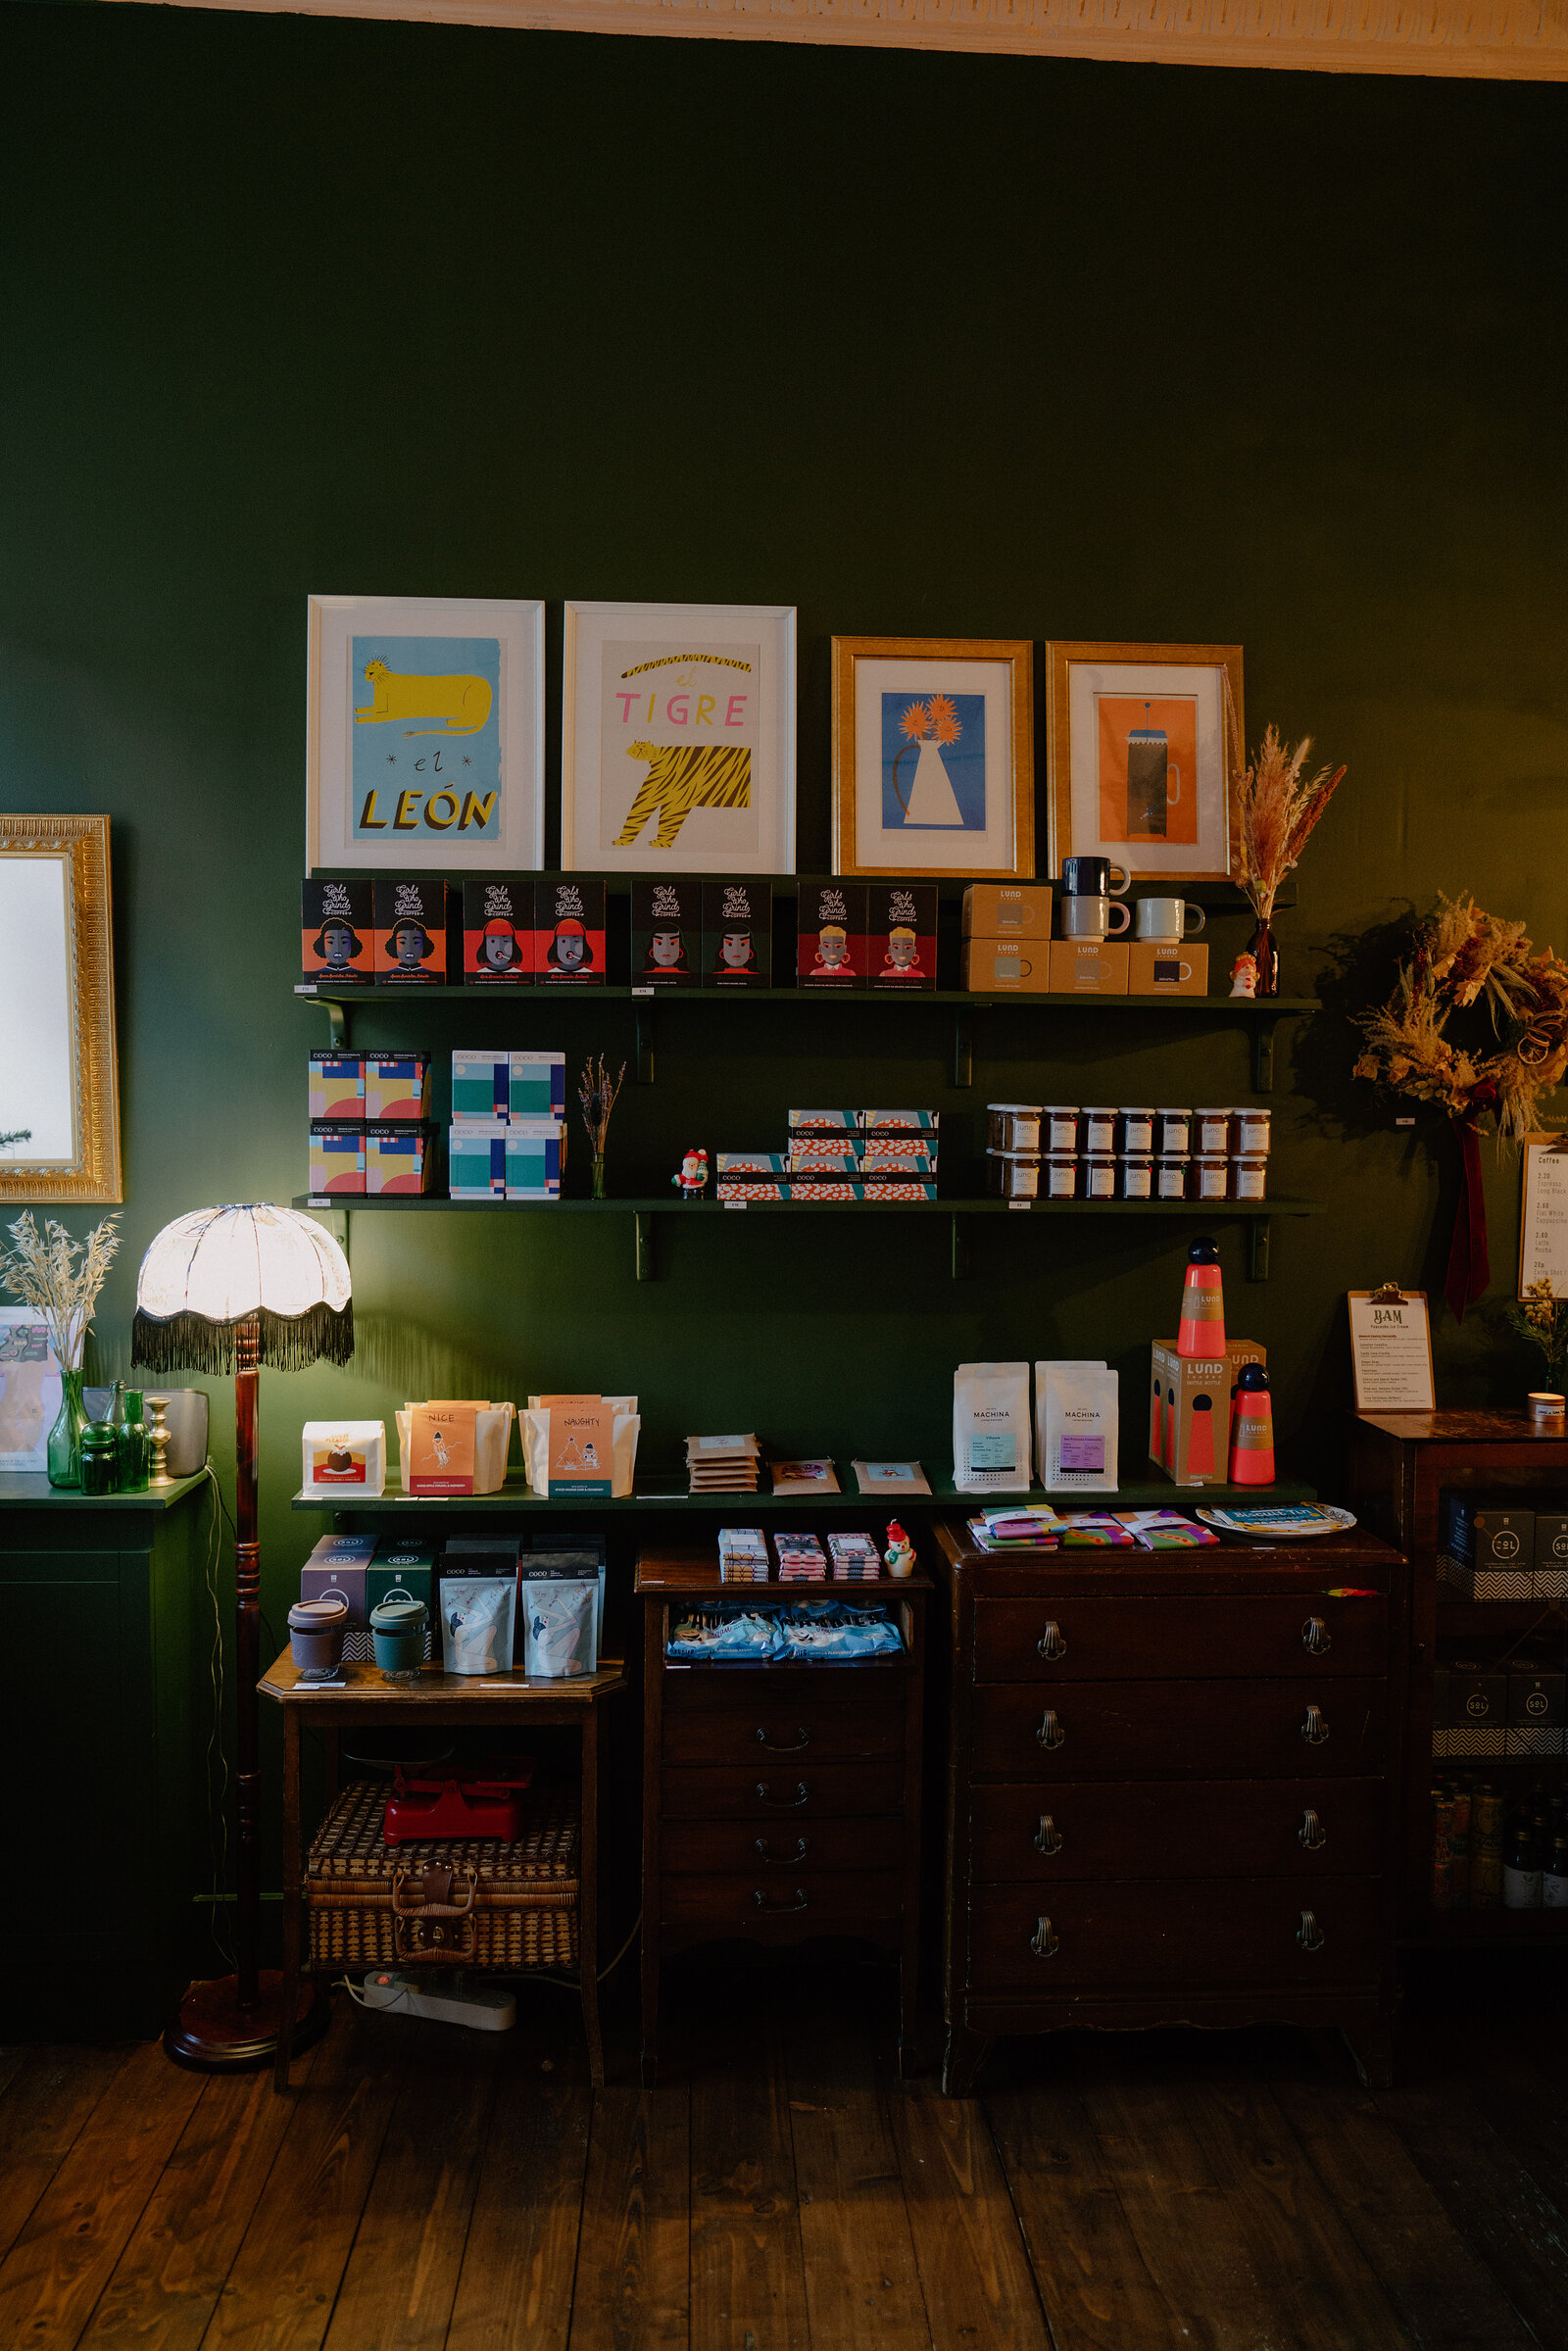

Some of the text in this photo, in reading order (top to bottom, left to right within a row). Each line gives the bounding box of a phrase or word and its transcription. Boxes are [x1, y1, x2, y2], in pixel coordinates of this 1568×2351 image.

[675, 666, 697, 687] el
[616, 693, 748, 727] TIGRE
[414, 751, 444, 772] el
[359, 783, 498, 831] LEÓN
[323, 884, 347, 895] Girls
[396, 884, 419, 895] Girls
[486, 885, 509, 896] Girls
[557, 885, 580, 896] Girls
[654, 886, 676, 896] Girls
[724, 887, 747, 897] Girls
[820, 889, 843, 900] Girls
[891, 891, 912, 901] Girls
[322, 899, 352, 910] Grind
[395, 900, 423, 910] Grind
[485, 901, 514, 911] Grind
[556, 901, 584, 911] Grind
[652, 902, 680, 911] Grind
[723, 903, 751, 912] Grind
[819, 906, 847, 914] Grind
[889, 907, 916, 917] Grind
[1374, 1309, 1402, 1324] BAM
[1232, 1354, 1259, 1364] UND
[1188, 1363, 1224, 1374] LUND
[428, 1414, 455, 1423] NICE
[564, 1417, 600, 1427] NAUGHTY
[1495, 1540, 1516, 1550] SOL
[1470, 1701, 1486, 1710] SOL
[1529, 1700, 1545, 1709] SOL
